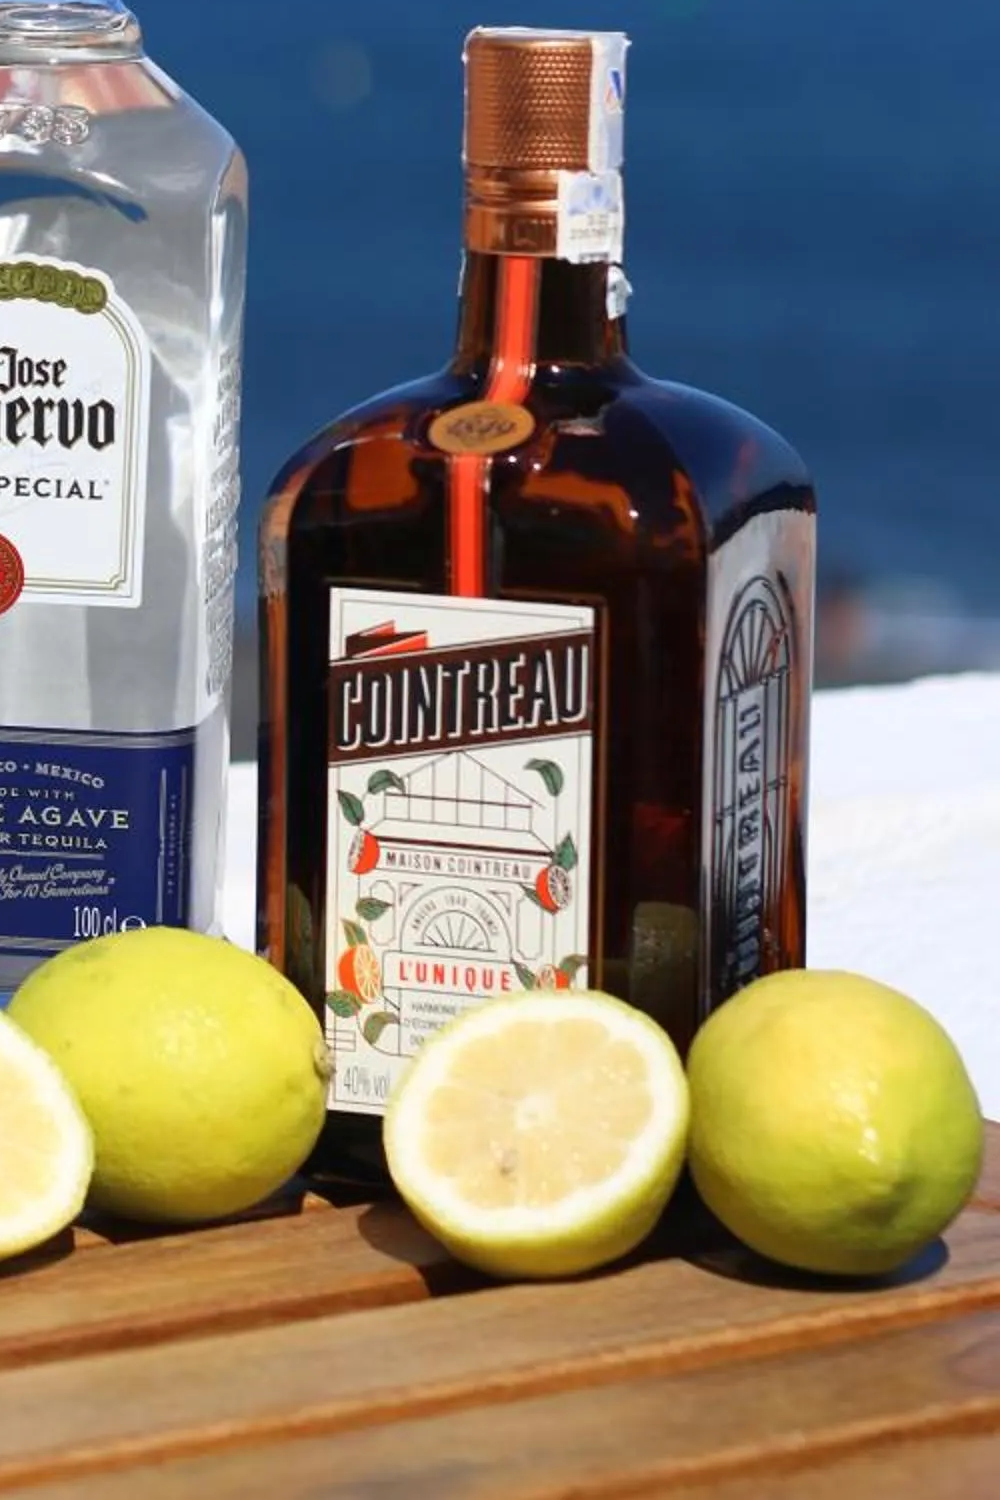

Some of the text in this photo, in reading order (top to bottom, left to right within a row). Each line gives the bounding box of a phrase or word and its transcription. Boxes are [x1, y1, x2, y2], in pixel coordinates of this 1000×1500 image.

[336, 644, 590, 751] COINTREAU
[35, 762, 105, 789] MEXICO
[28, 789, 74, 800] WITH
[18, 806, 130, 830] AGAVE
[18, 833, 109, 850] TEQUILA
[9, 864, 50, 881] Owned
[386, 851, 532, 879] MAISON COINTREAU
[23, 883, 39, 897] 10
[73, 905, 101, 937] 100
[399, 960, 513, 992] L'UNIQUE
